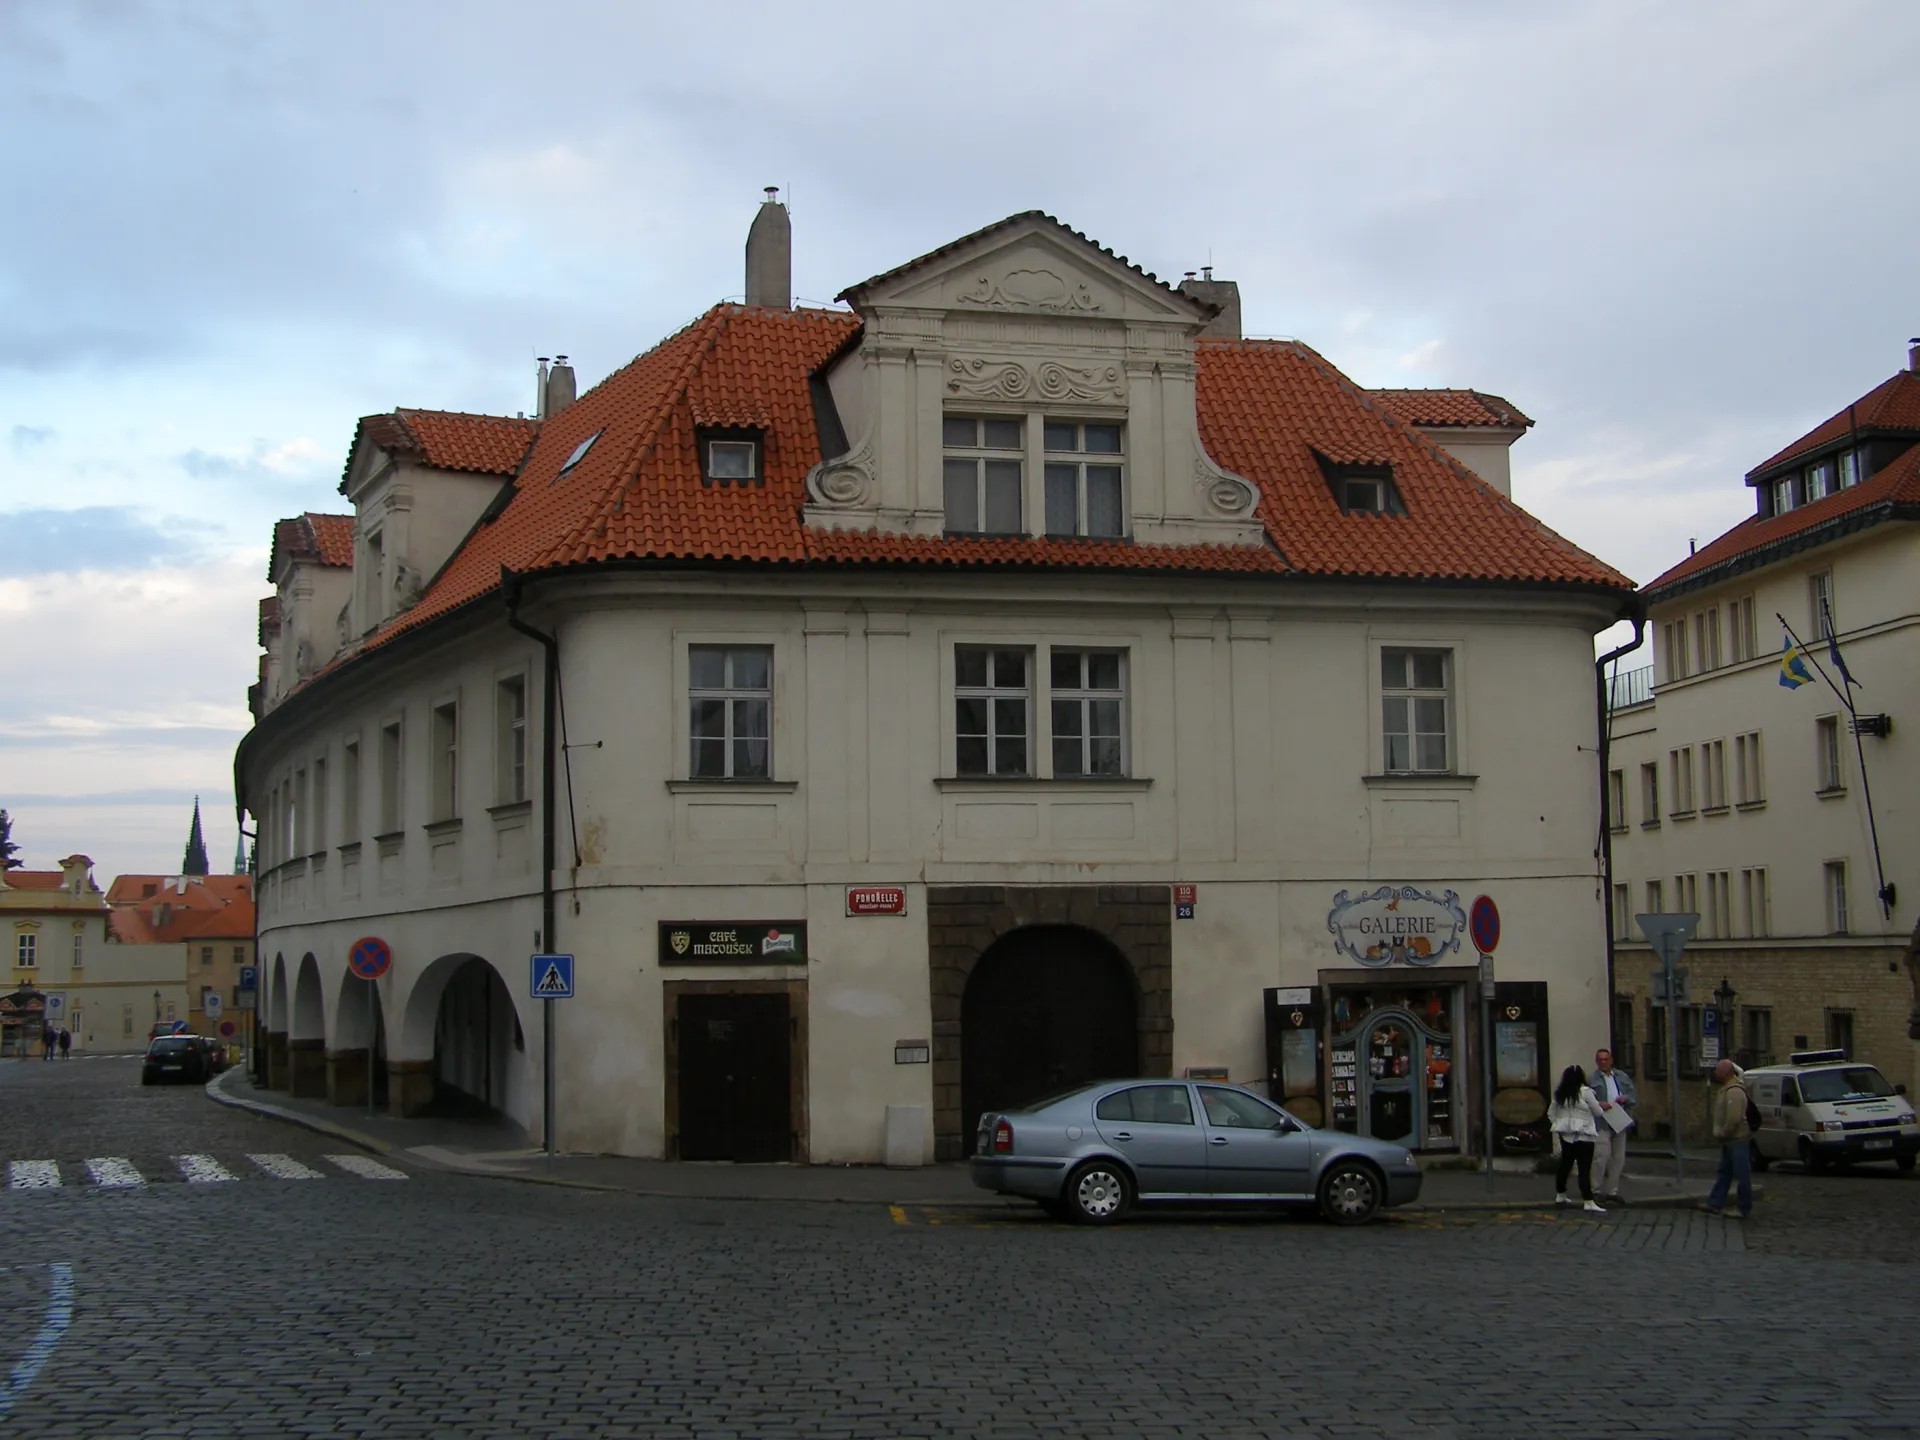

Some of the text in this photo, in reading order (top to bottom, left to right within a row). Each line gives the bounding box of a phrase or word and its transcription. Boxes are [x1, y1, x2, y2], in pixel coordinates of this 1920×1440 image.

[855, 892, 898, 903] POHOŘELEC
[1179, 907, 1191, 916] 26
[1359, 917, 1436, 934] GALERIE
[709, 929, 737, 942] CAFÉ
[693, 942, 753, 955] MATOUŠEK
[243, 969, 254, 984] P
[1705, 1011, 1715, 1028] P
